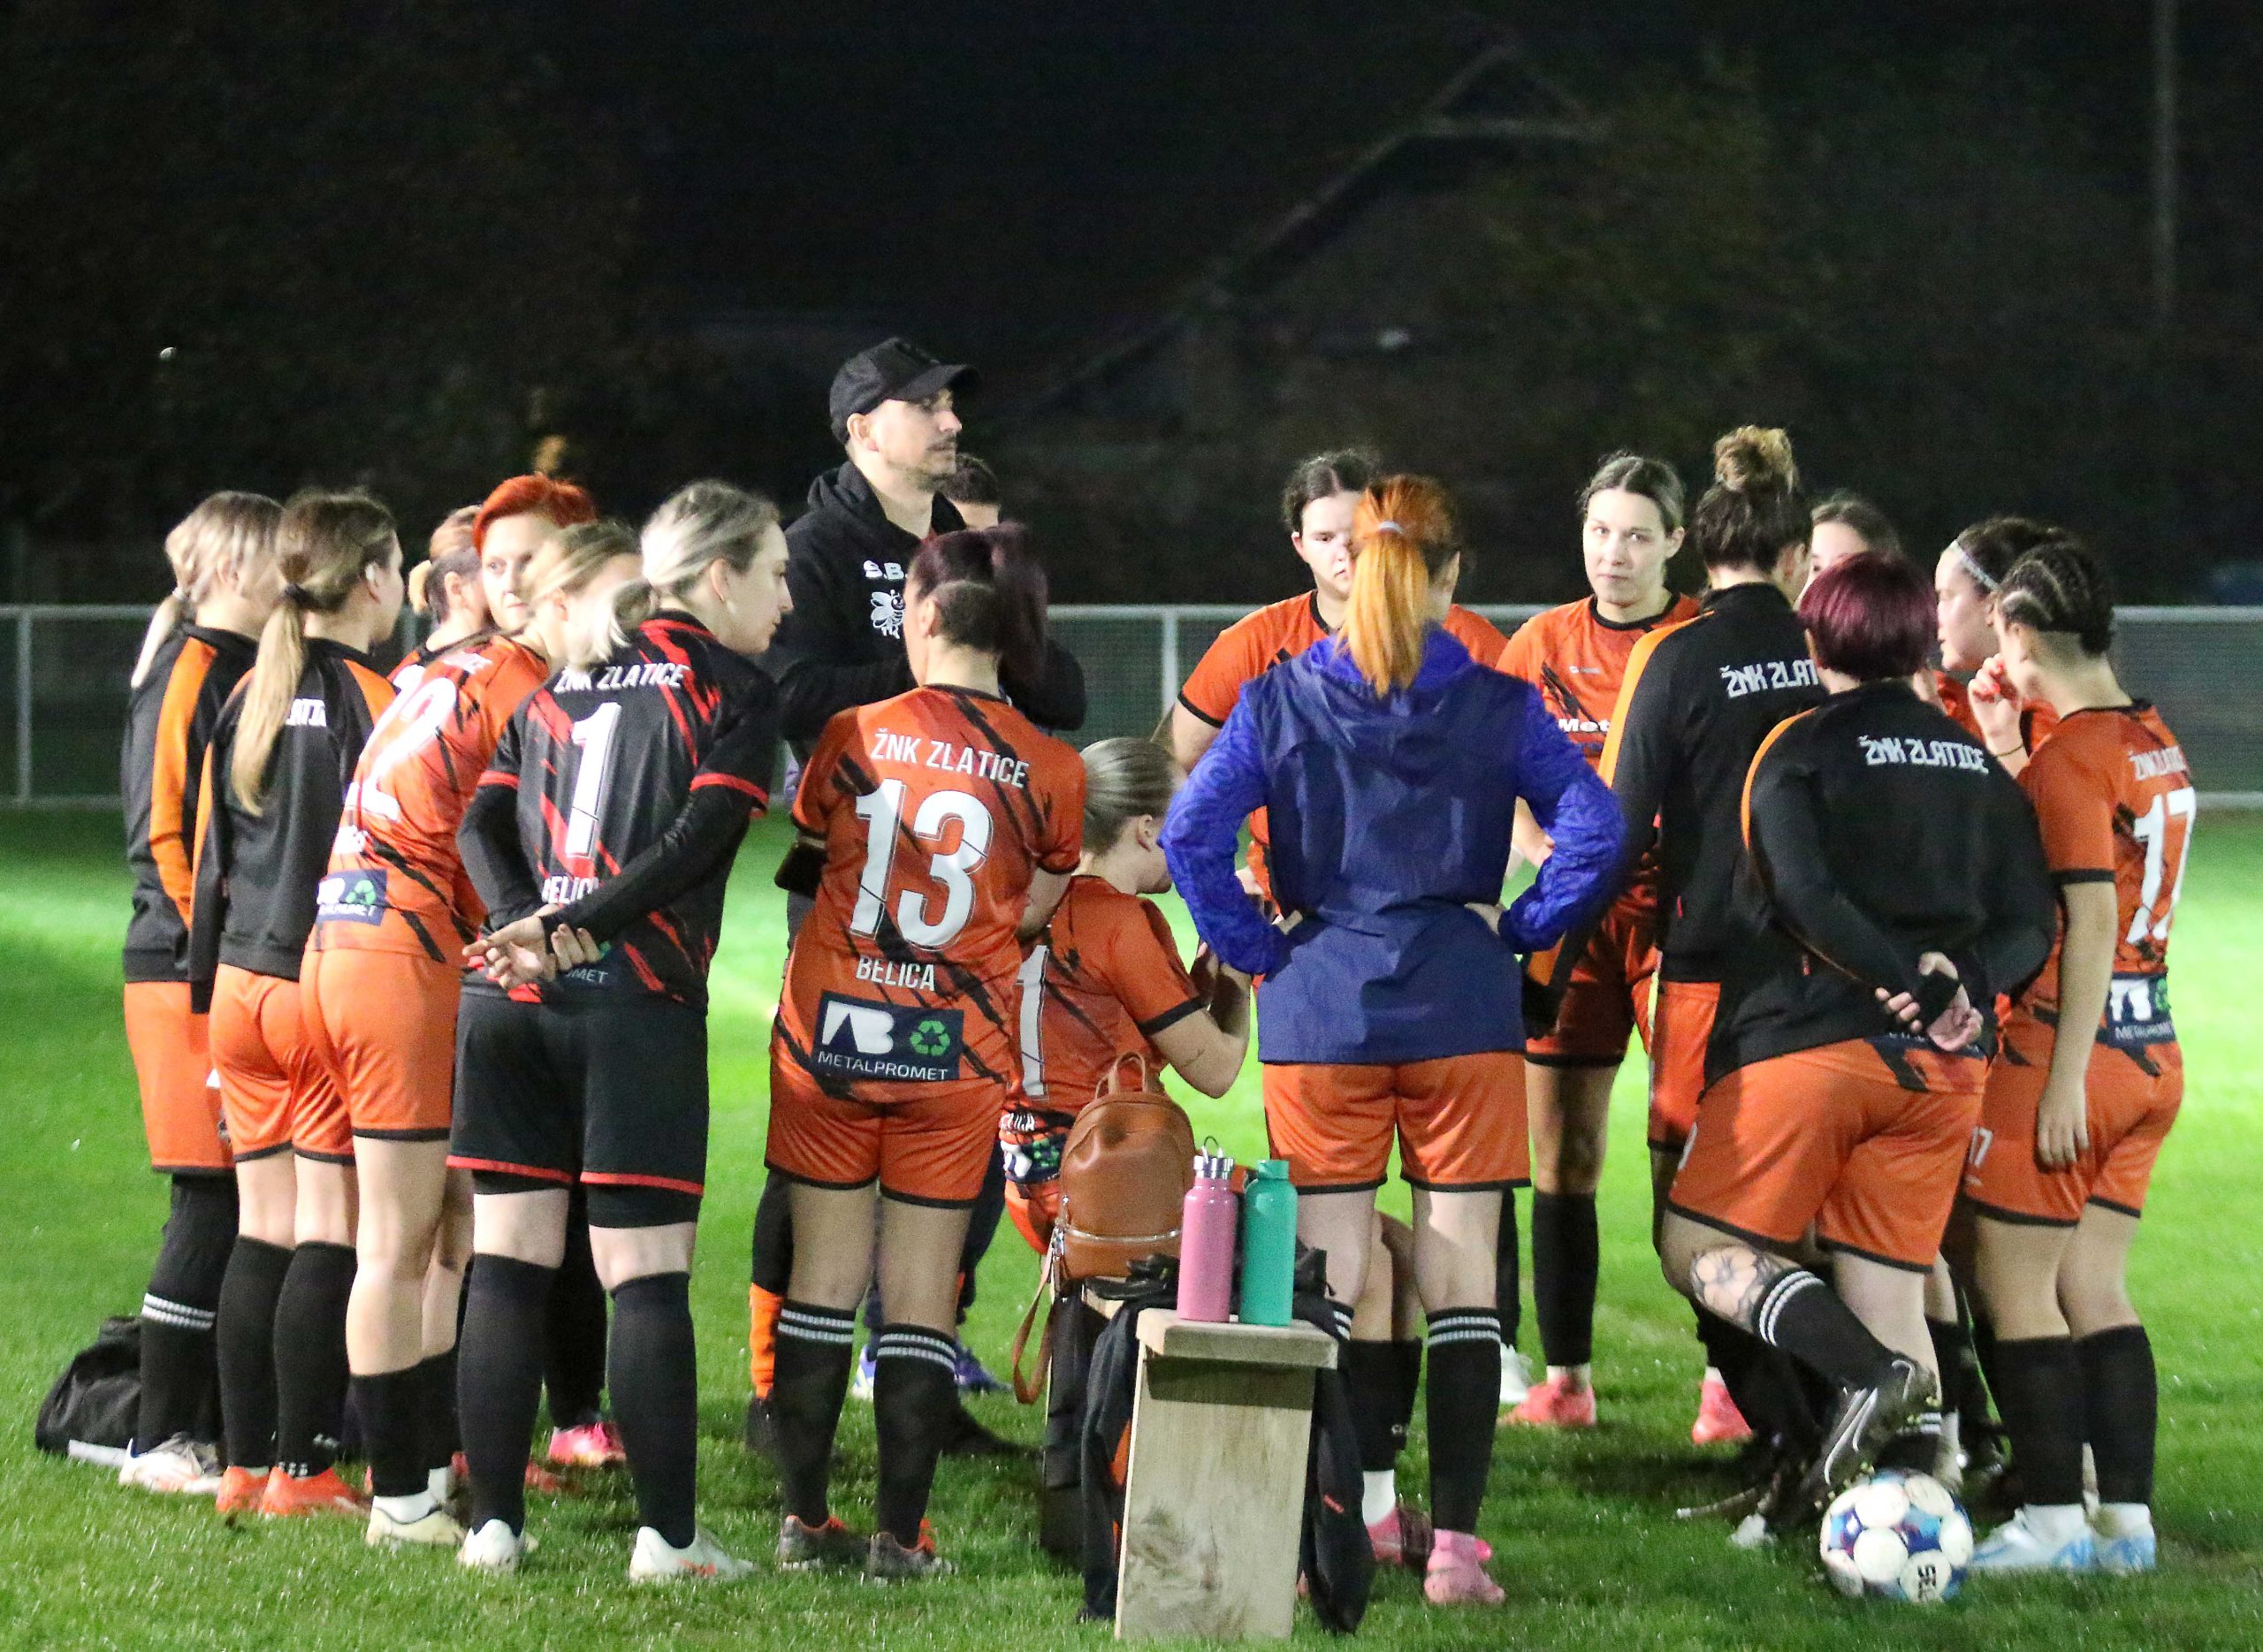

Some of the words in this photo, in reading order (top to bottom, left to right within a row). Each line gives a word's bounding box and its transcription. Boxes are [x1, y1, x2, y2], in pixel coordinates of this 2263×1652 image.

[597, 662, 691, 691] ZLATICE
[564, 701, 622, 859] 1
[870, 727, 922, 764] ŽNK
[926, 740, 1031, 788] ZLATICE
[850, 778, 994, 951] 13
[2126, 787, 2197, 944] 17
[856, 954, 935, 992] BELICA
[818, 1050, 949, 1081] METALPROMET
